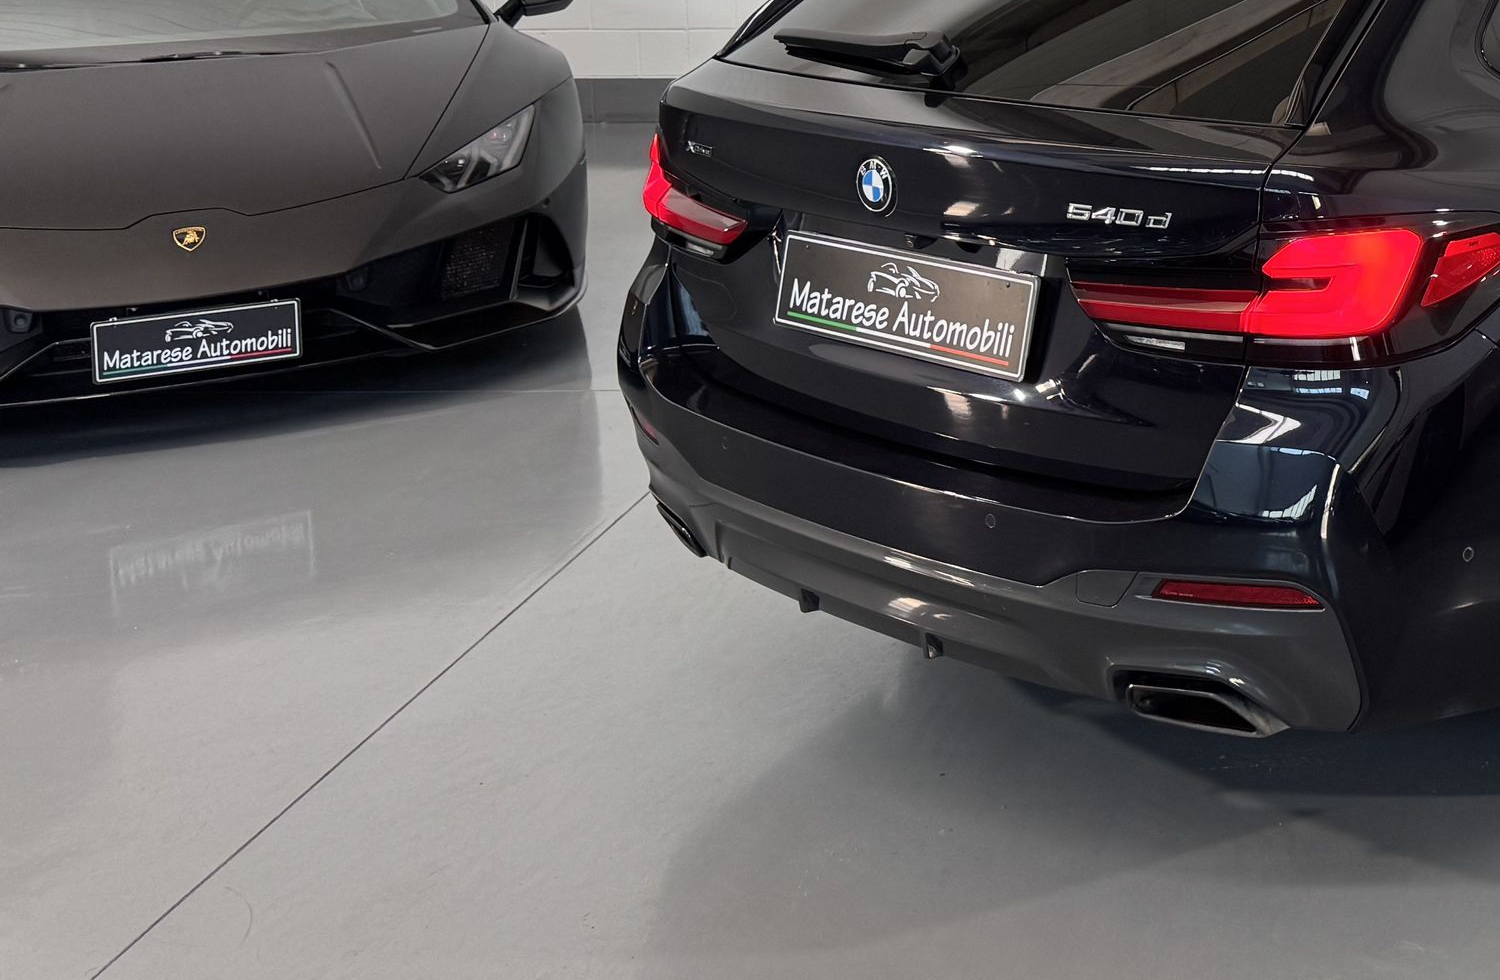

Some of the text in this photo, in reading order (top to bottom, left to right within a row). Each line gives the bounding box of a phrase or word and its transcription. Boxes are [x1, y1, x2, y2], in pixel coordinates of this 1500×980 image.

[789, 278, 1015, 358] Matarese Automobili
[103, 328, 292, 371] Matarese Automobili
